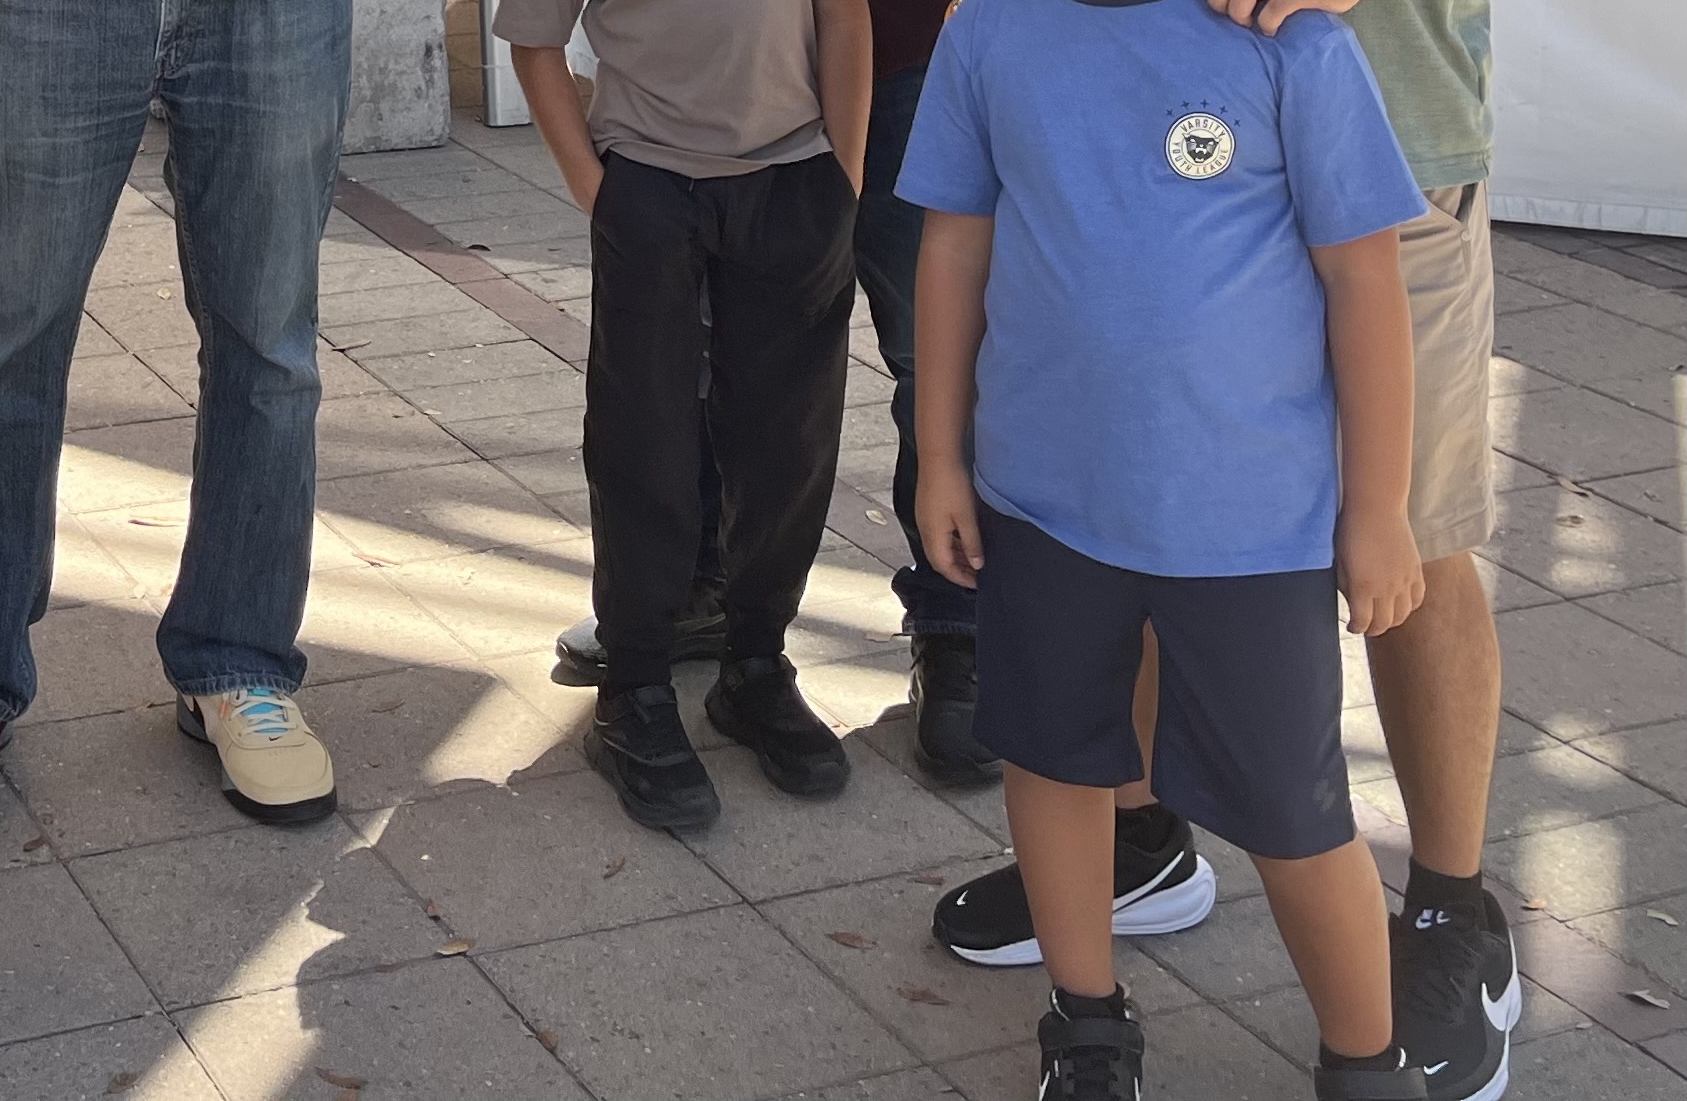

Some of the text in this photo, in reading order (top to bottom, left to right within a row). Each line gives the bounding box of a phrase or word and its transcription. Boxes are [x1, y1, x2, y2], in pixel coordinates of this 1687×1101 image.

[1179, 118, 1226, 139] VARSITY
[1172, 141, 1229, 175] YOUTH LEAGUE
